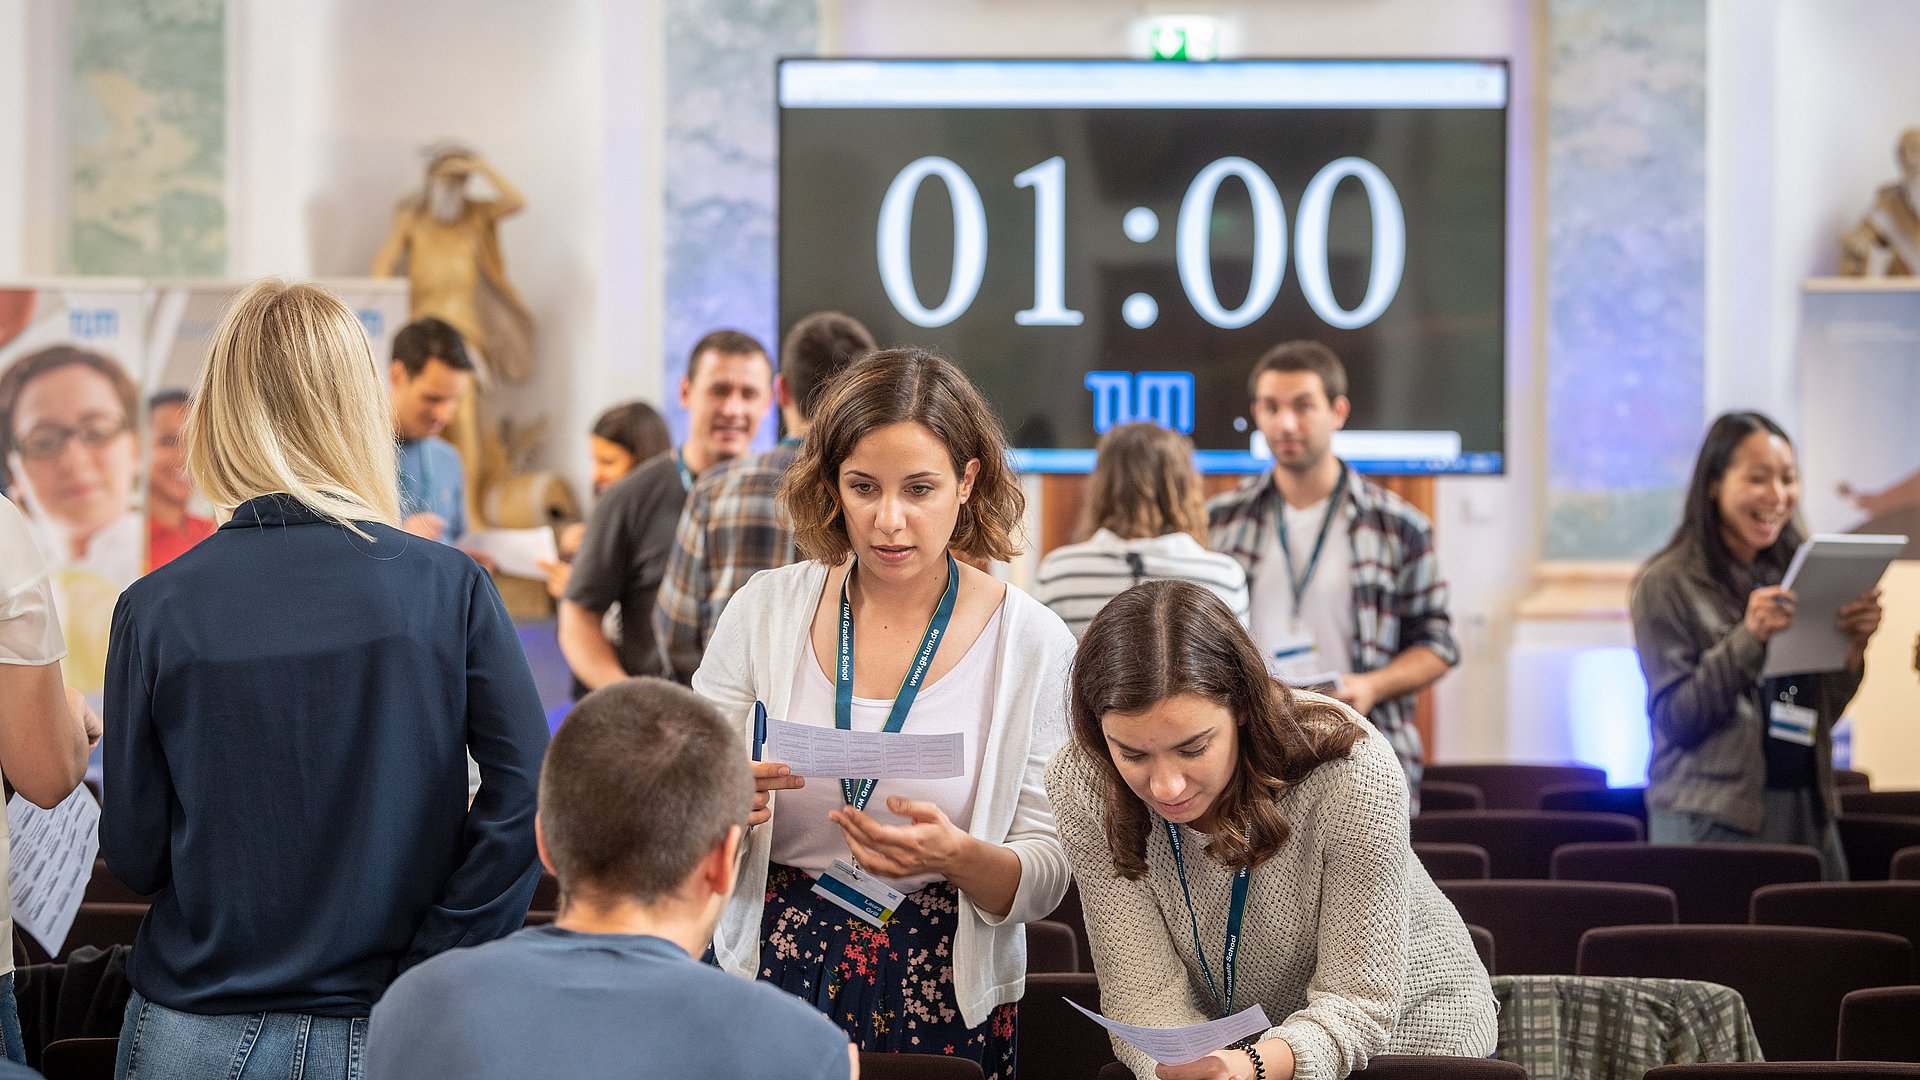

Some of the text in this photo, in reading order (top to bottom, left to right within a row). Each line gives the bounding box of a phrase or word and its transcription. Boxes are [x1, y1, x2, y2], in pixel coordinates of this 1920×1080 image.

[876, 155, 1407, 330] 01:00
[1084, 370, 1195, 435] TUM
[842, 620, 850, 655] Graduate
[842, 655, 850, 681] School
[909, 628, 940, 687] www.gs.tum.de
[856, 778, 873, 812] UM Grad
[864, 899, 883, 912] Laura
[1225, 934, 1237, 962] School
